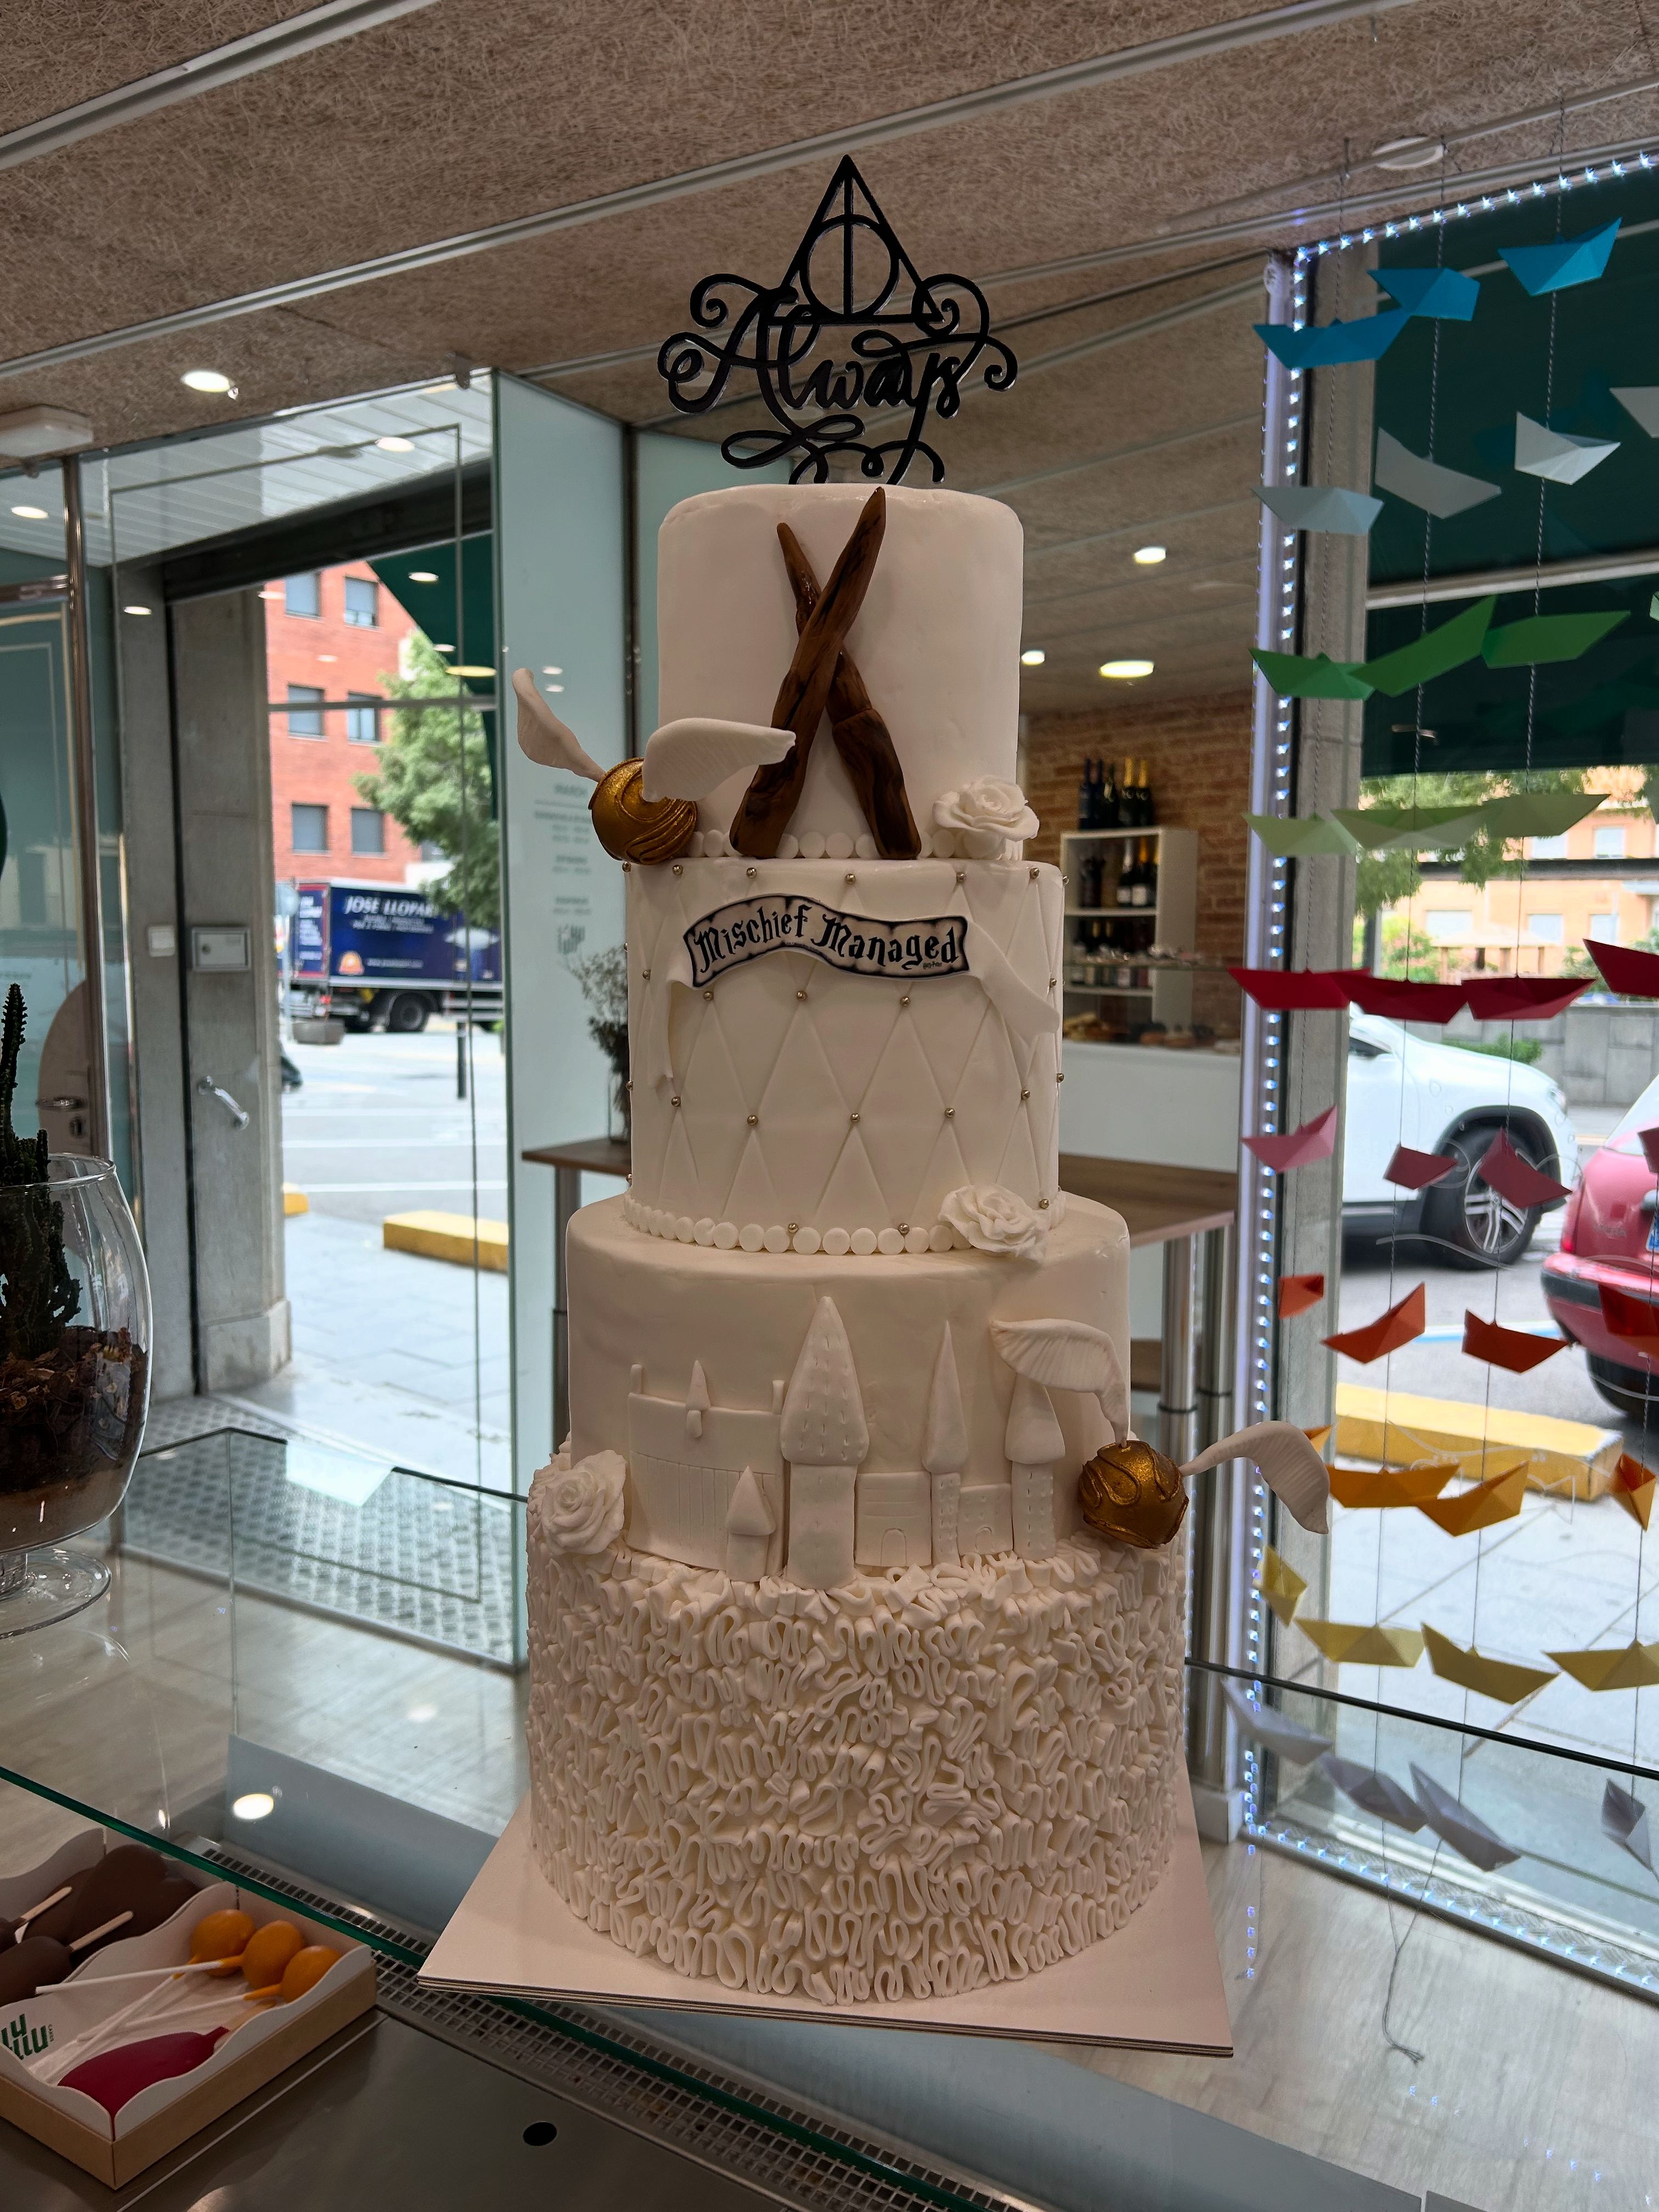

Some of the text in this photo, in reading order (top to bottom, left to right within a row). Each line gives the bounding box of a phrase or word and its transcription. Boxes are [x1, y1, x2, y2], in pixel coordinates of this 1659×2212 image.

[657, 273, 1004, 476] Always
[344, 895, 381, 915] JOSE
[693, 904, 959, 973] Mischief Managed
